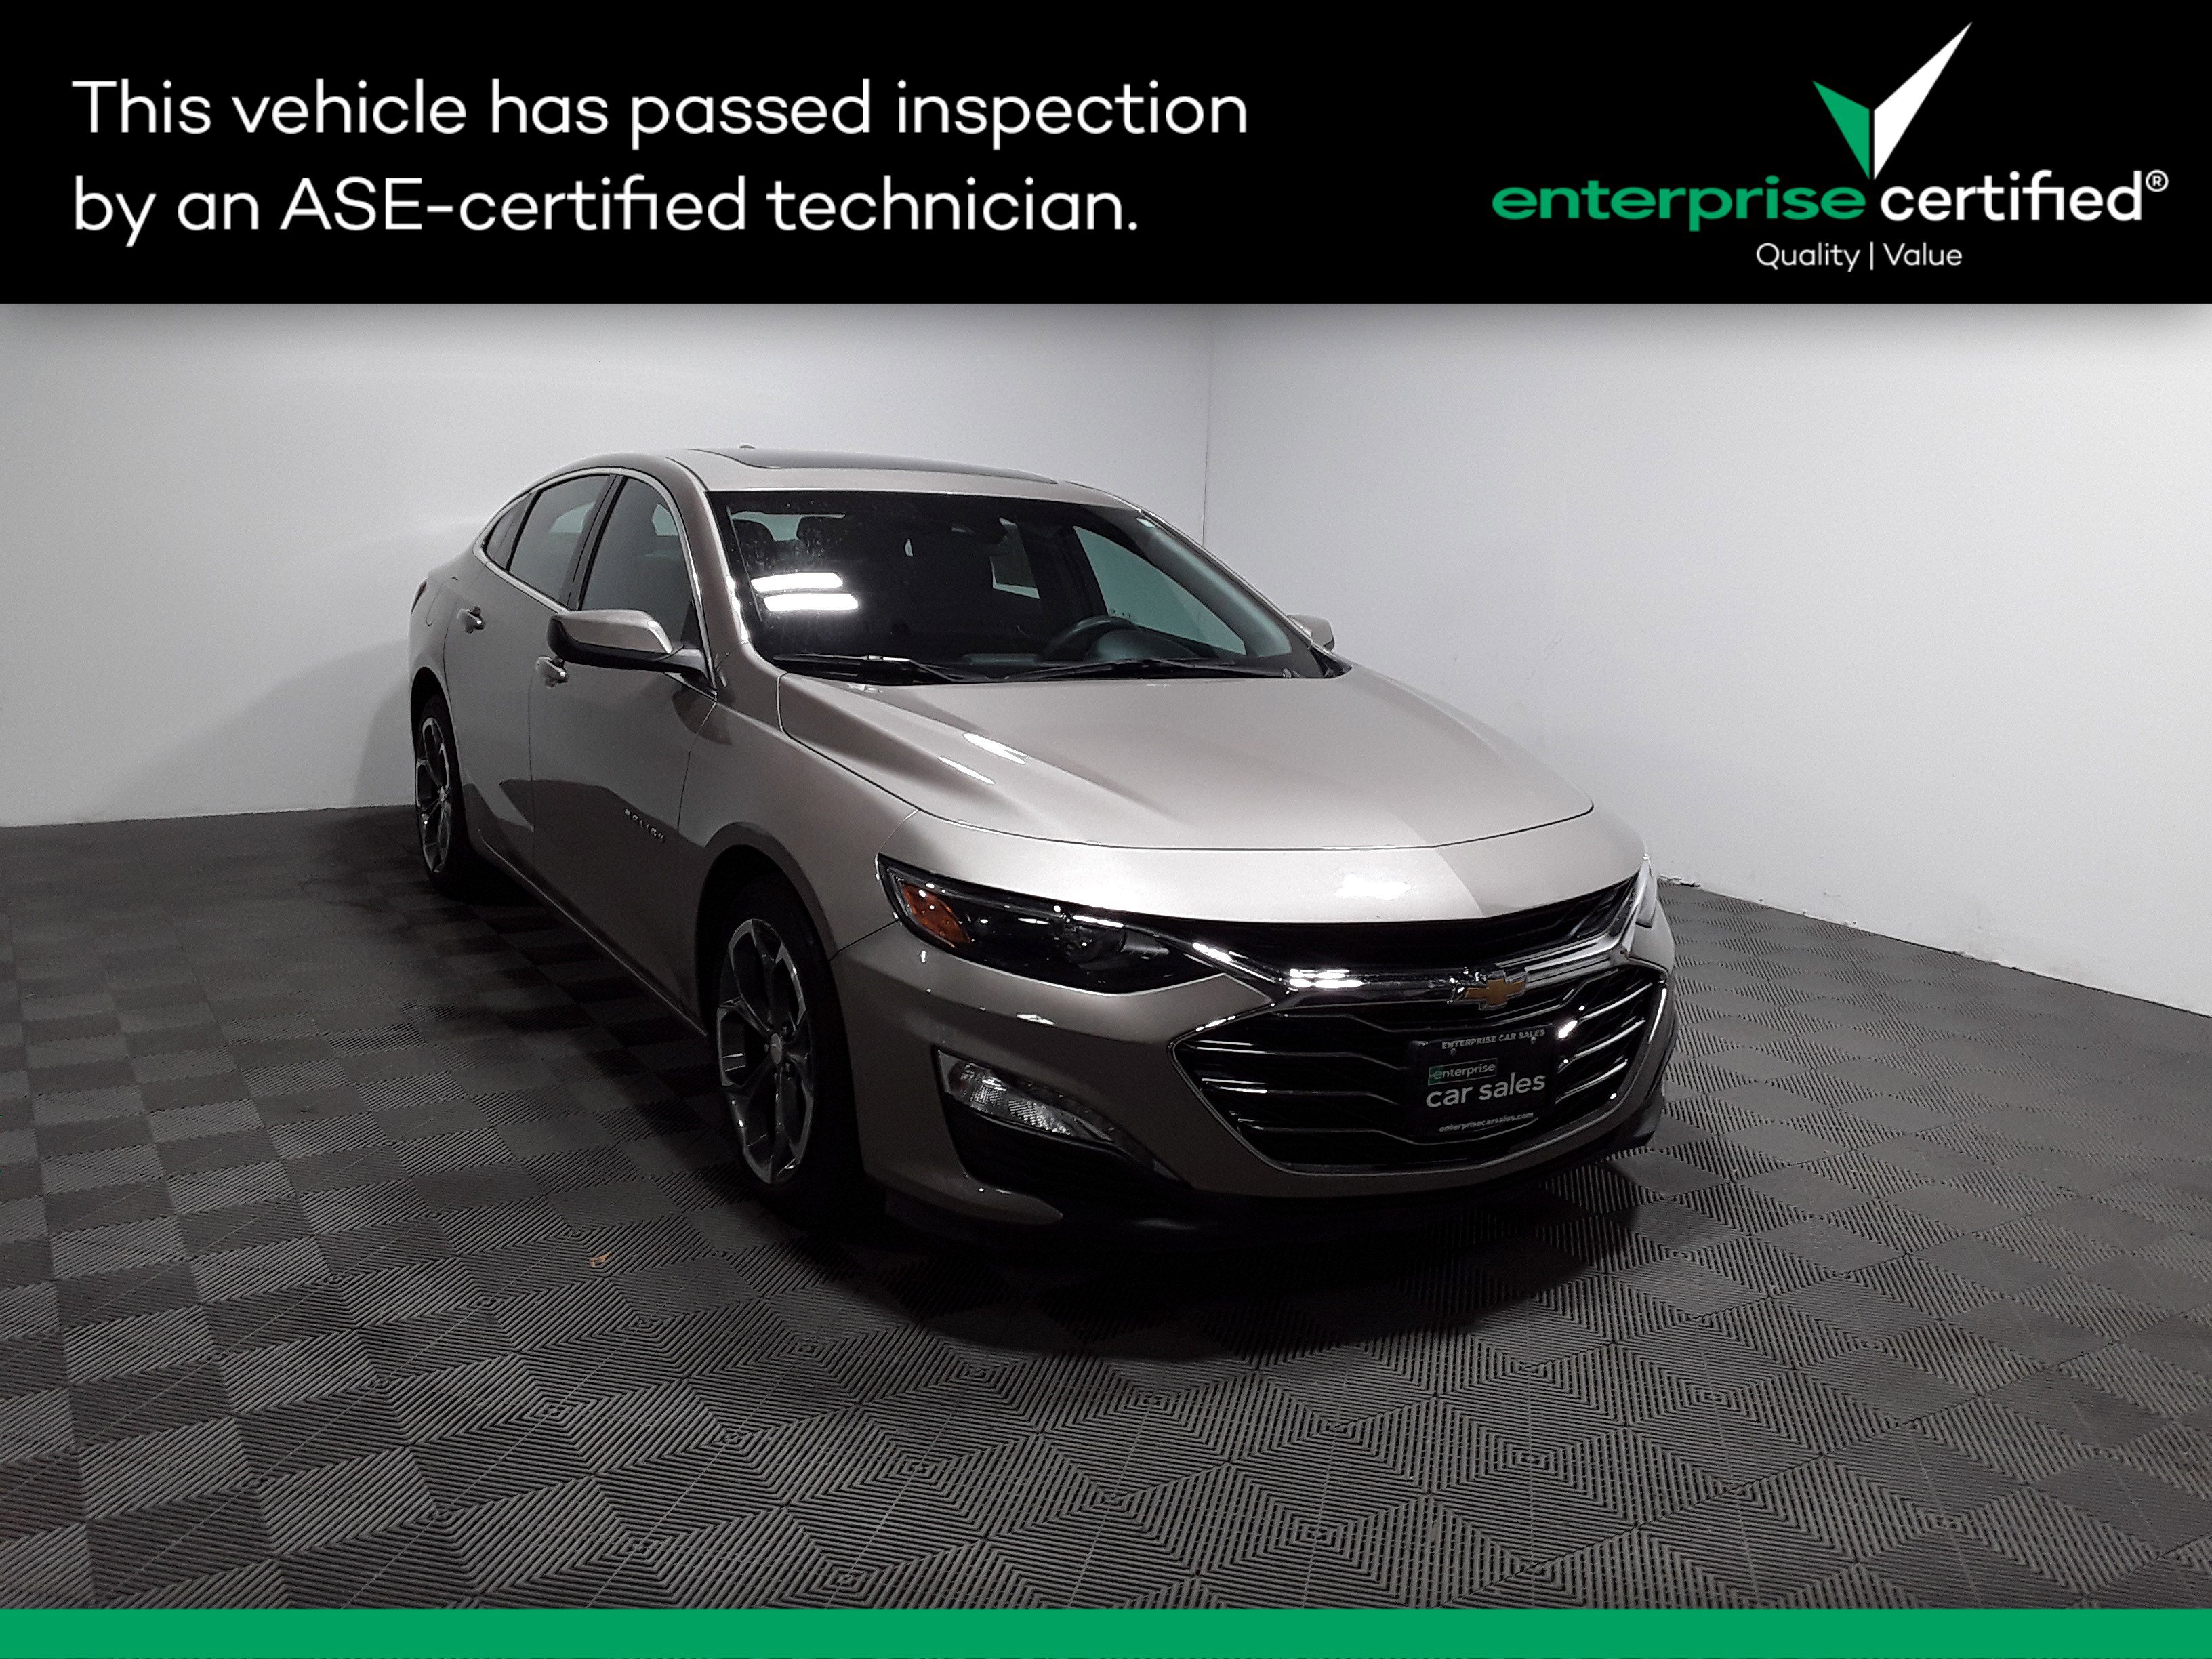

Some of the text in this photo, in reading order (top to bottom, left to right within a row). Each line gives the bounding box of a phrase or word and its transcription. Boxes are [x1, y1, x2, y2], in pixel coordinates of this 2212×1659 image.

[1441, 1029, 1545, 1049] ENTERPRISE CAR SALES
[1431, 1063, 1495, 1079] enterprise
[1426, 1071, 1546, 1108] car sales
